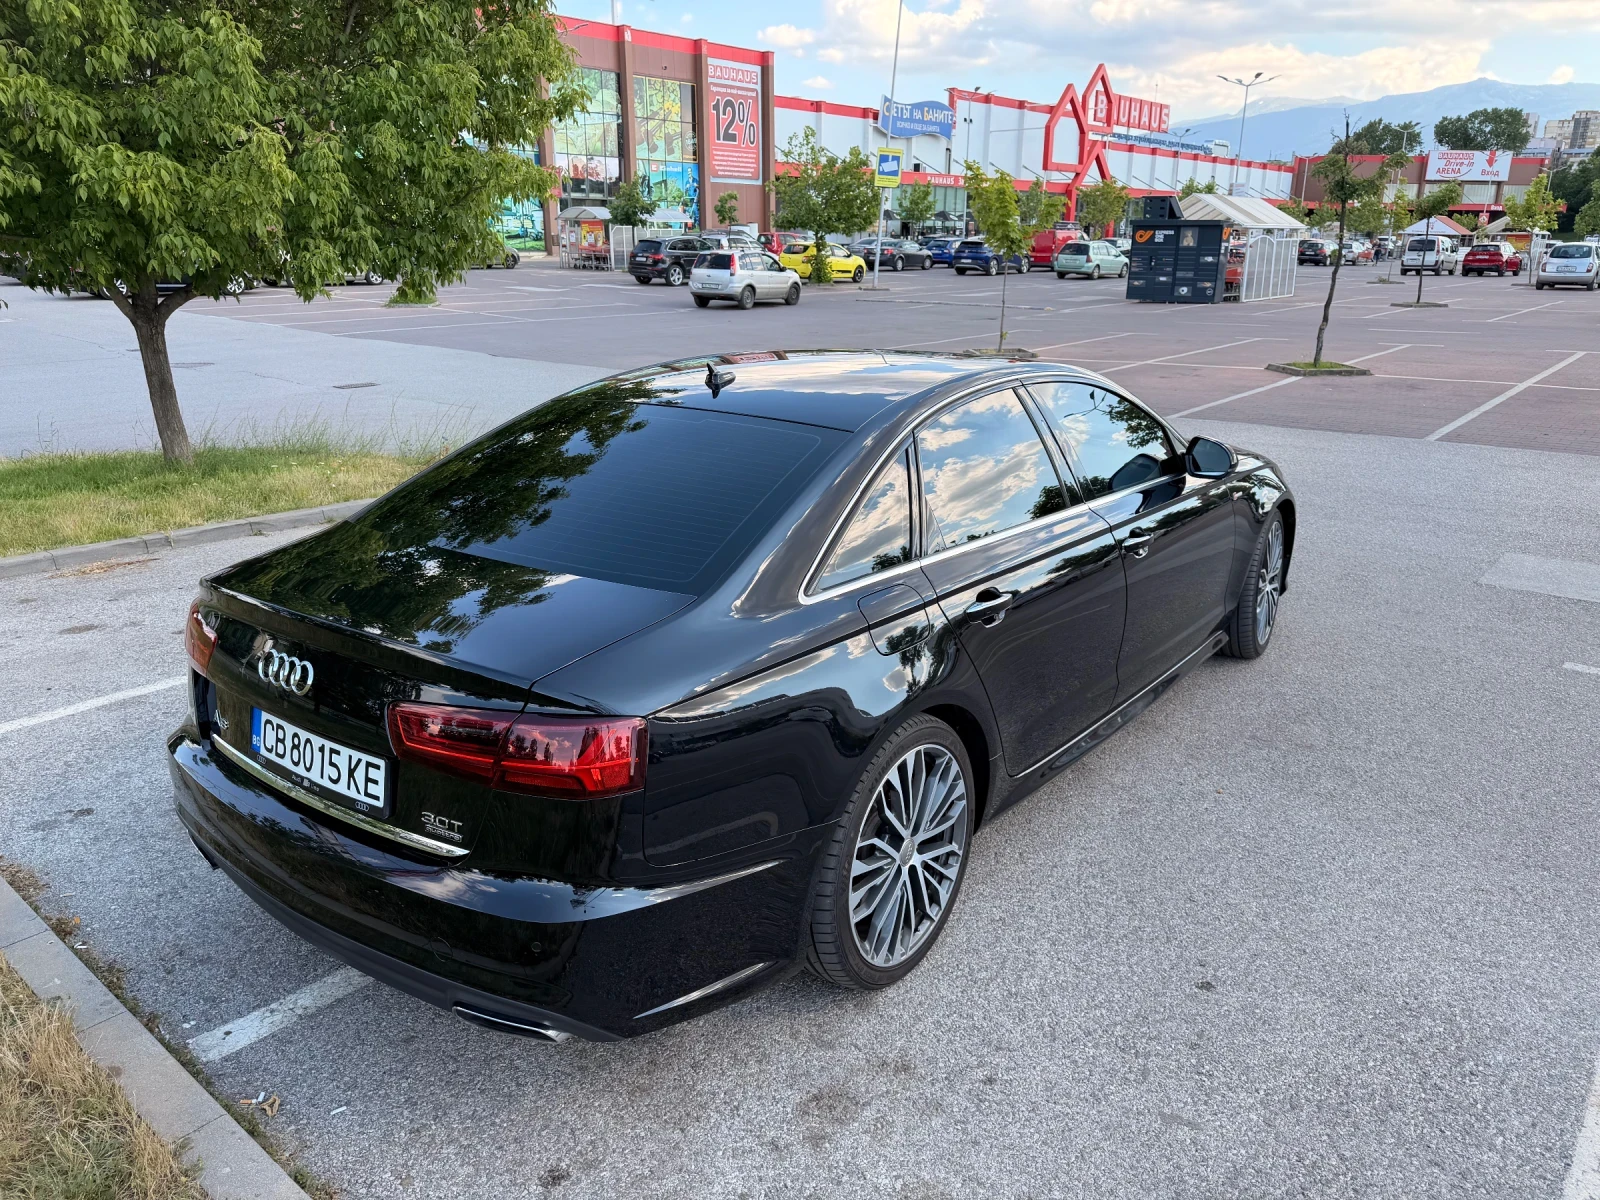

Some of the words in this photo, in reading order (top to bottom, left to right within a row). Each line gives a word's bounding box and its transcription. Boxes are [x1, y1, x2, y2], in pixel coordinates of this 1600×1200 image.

[708, 65, 758, 83] BAUHAUS
[711, 96, 756, 147] 12%
[883, 102, 911, 119] СЕТЪТ
[913, 109, 922, 120] НА
[924, 107, 952, 124] БАНИТЕ
[1097, 95, 1169, 129] BUHAUS
[1481, 169, 1499, 177] Вход
[252, 734, 262, 747] BG
